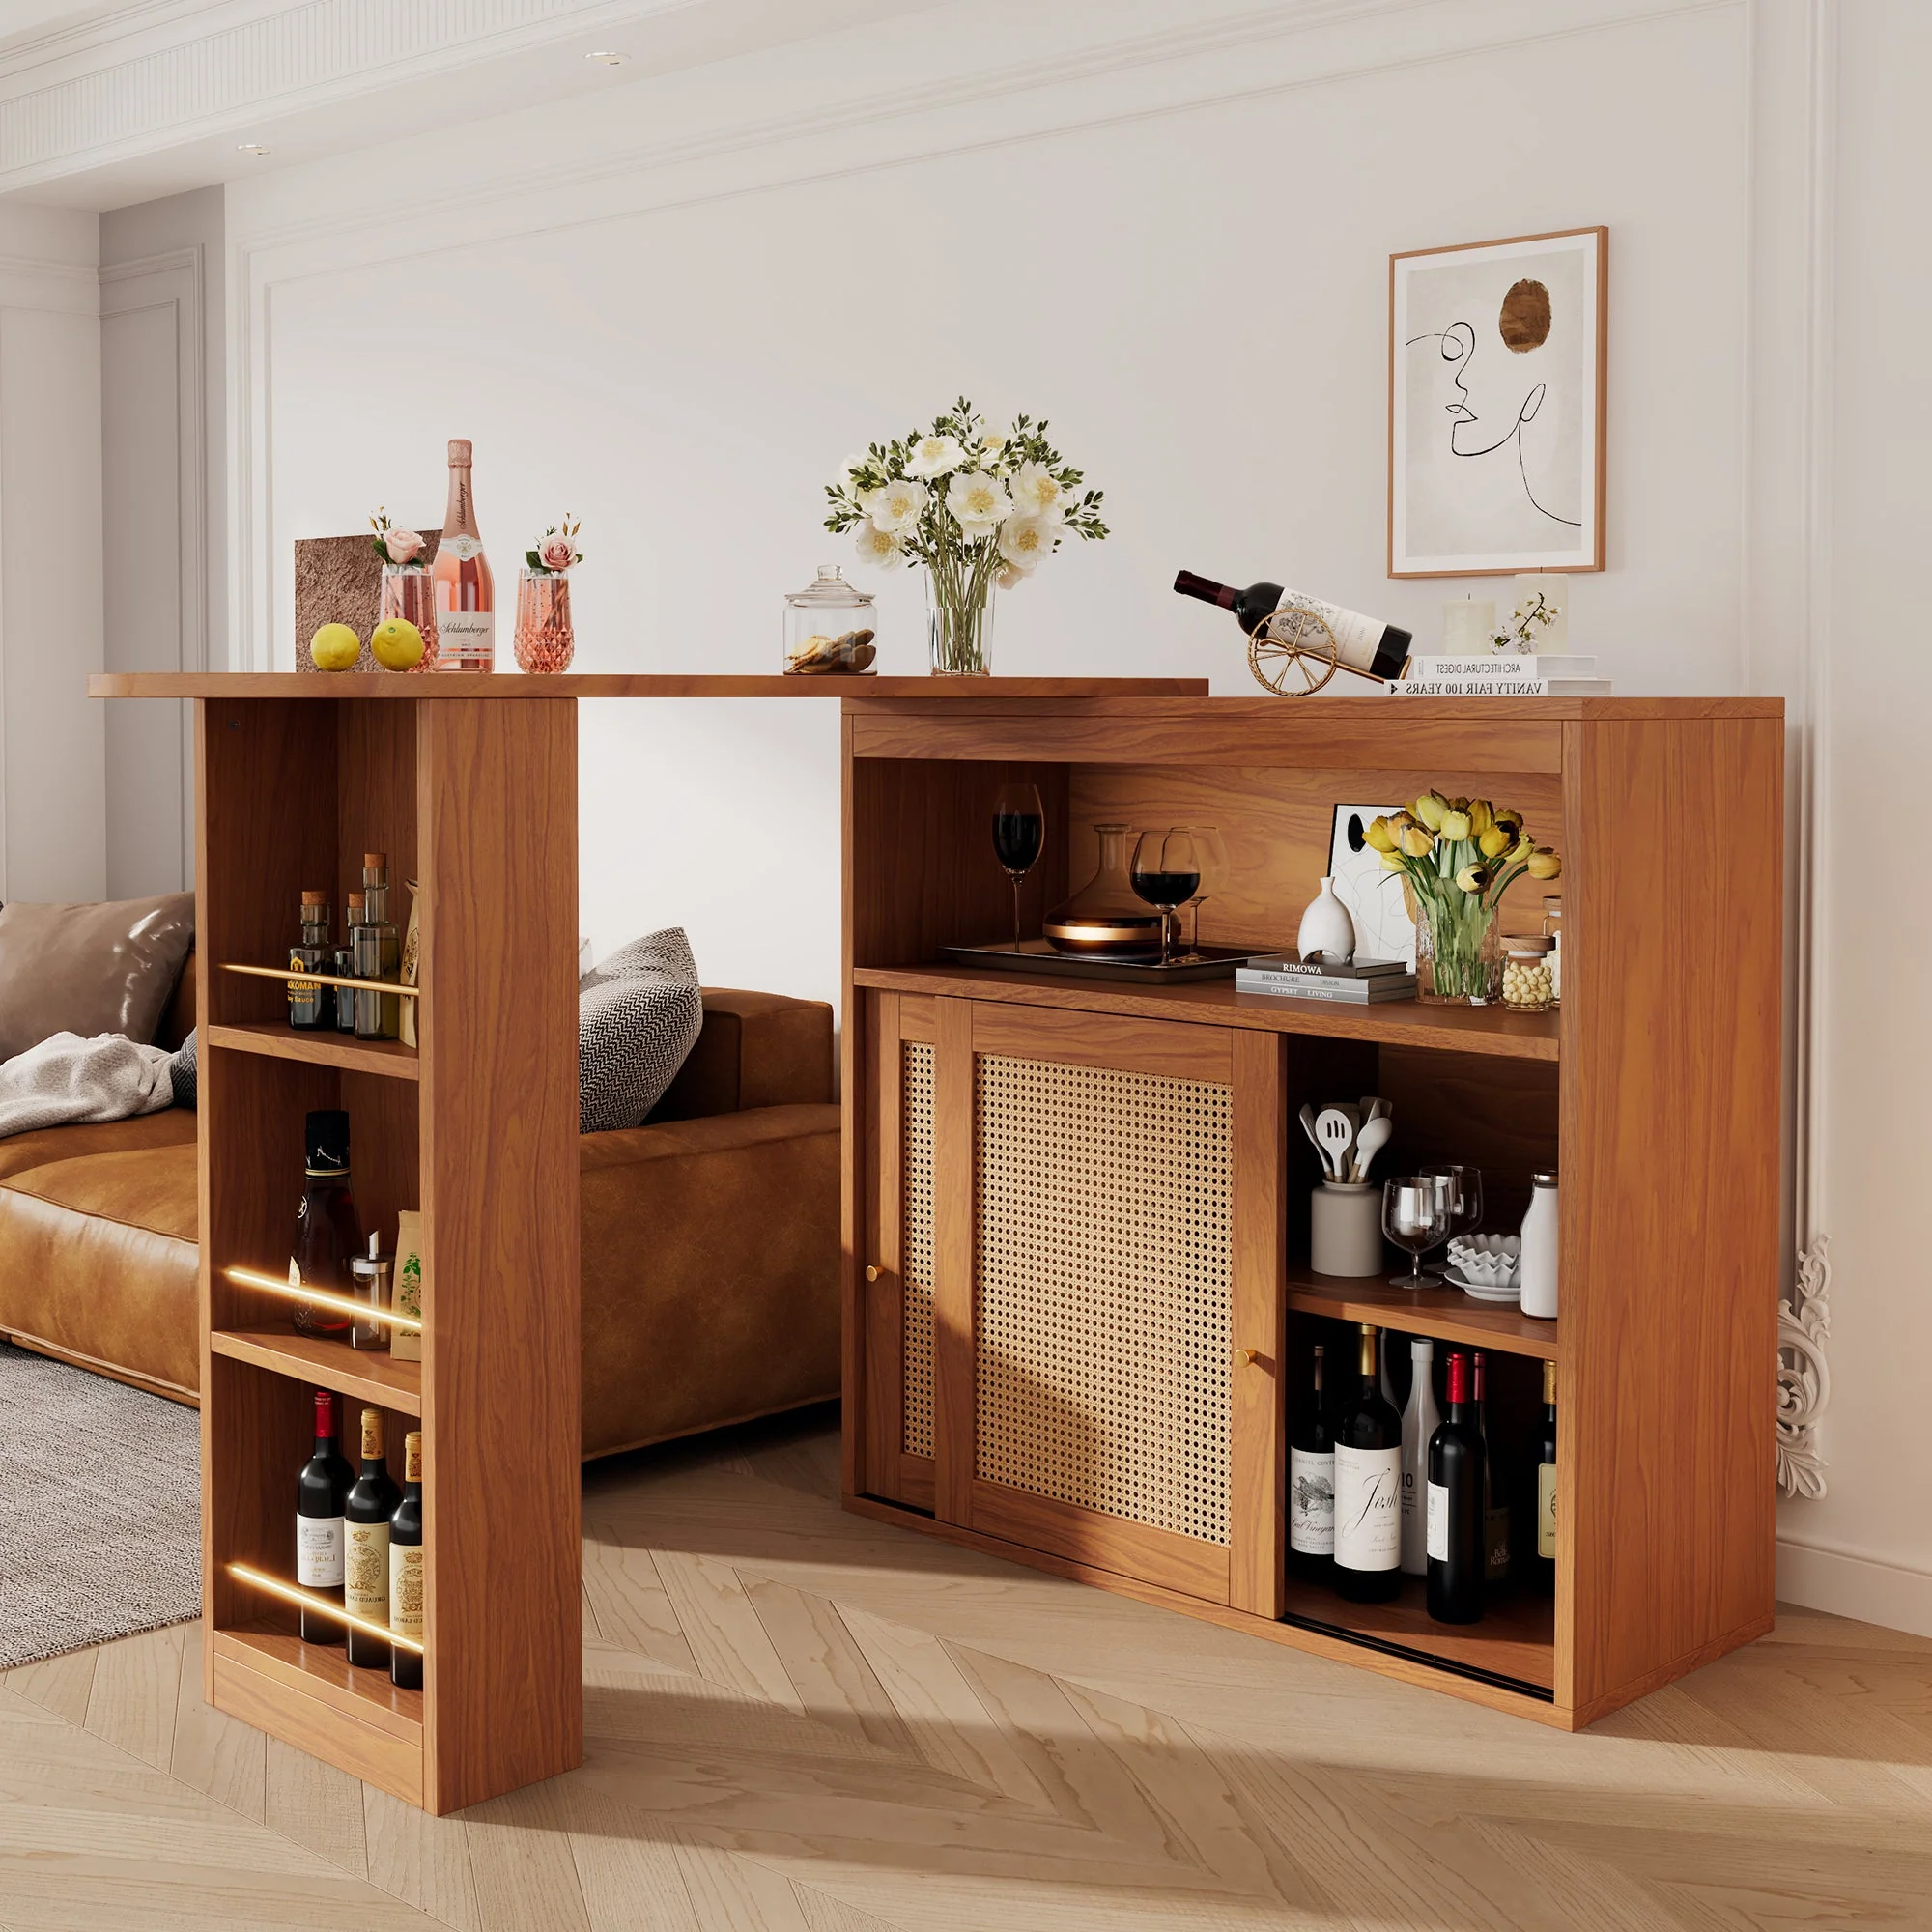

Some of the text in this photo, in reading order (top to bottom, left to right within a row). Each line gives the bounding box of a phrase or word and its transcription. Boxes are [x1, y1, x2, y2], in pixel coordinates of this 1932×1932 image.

[457, 480, 469, 530] Schlumberger
[440, 621, 490, 637] Schlumberger
[1282, 963, 1322, 975] RIMOWA
[1261, 974, 1300, 983] BROCHURE
[1270, 986, 1333, 999] GYPSET LIVING
[1342, 1467, 1401, 1538] Josh
